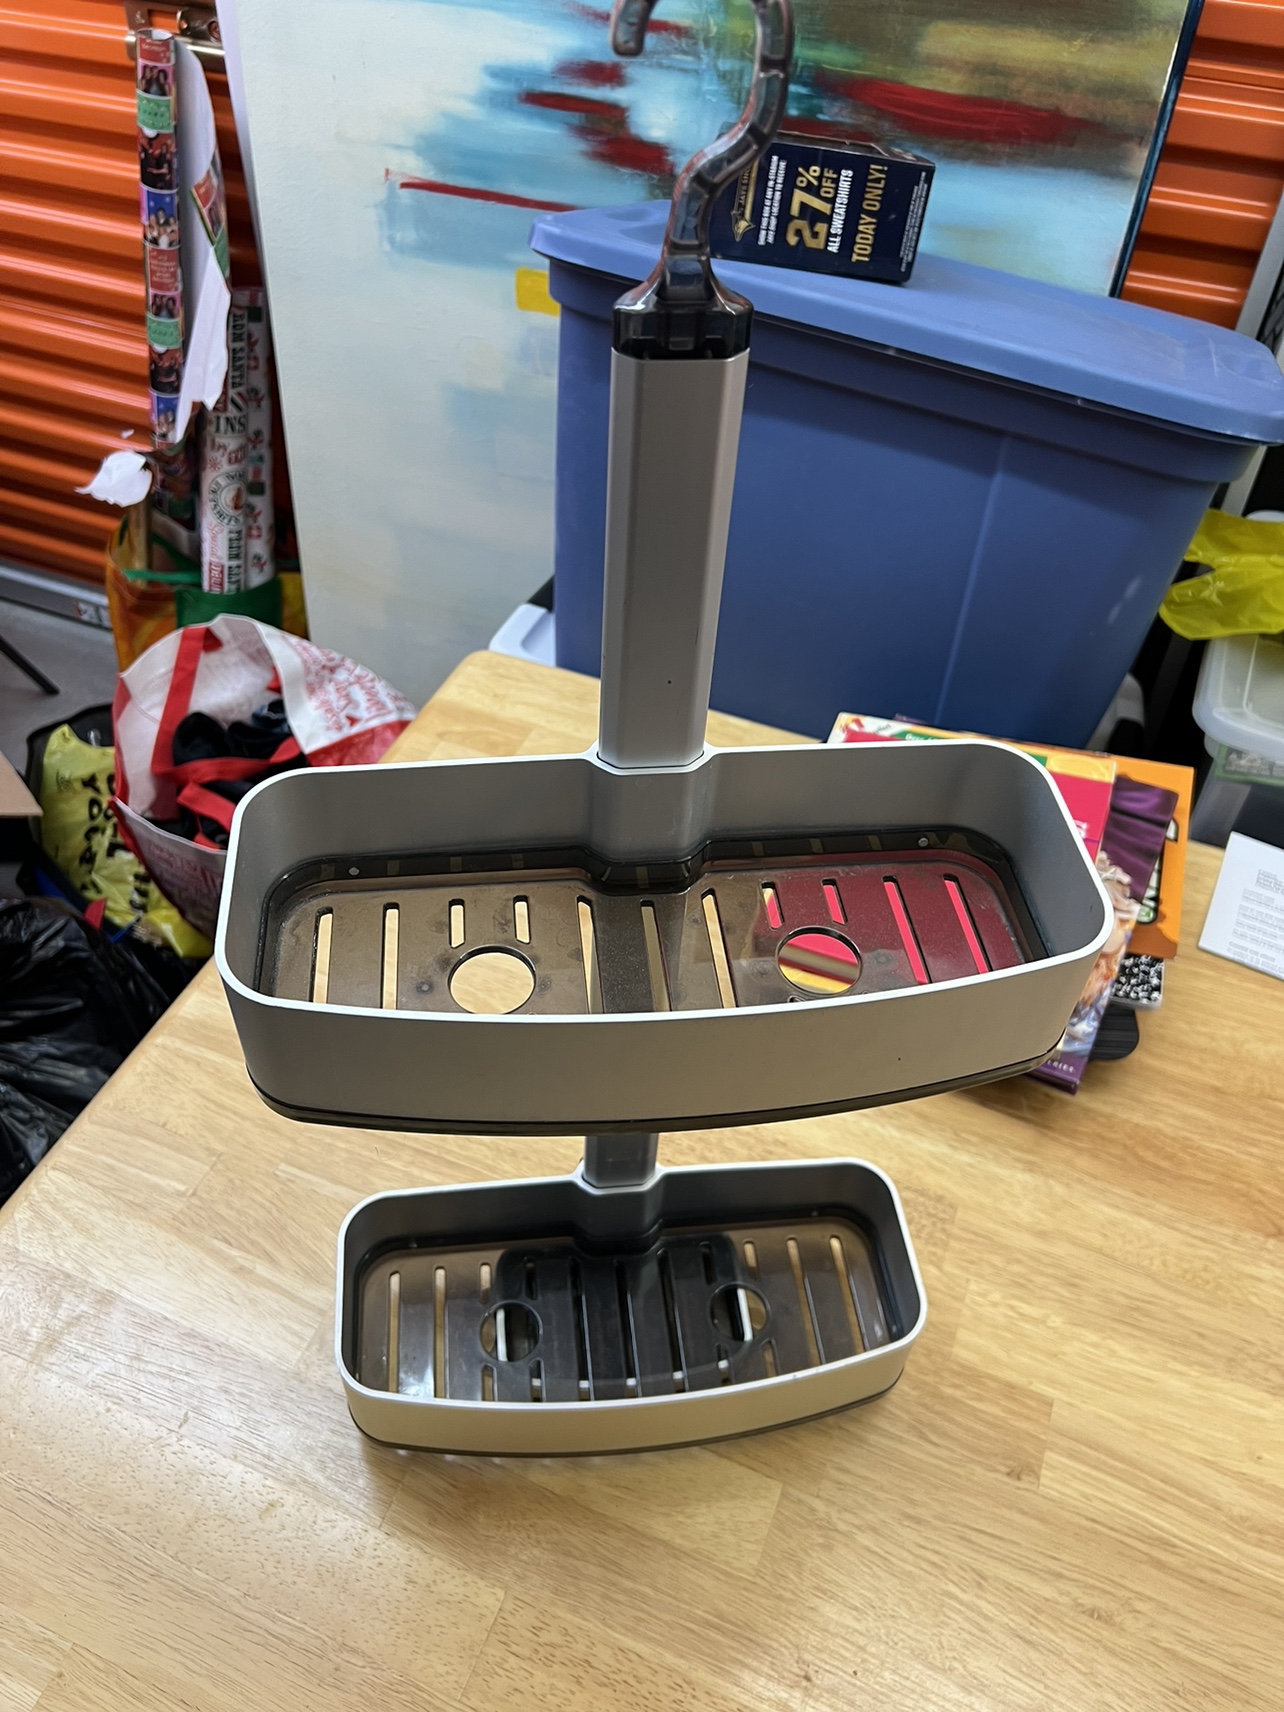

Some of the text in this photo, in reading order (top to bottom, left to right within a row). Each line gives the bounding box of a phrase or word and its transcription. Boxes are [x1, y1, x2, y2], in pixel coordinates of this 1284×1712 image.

[767, 155, 779, 187] IN-STADIUM
[765, 187, 774, 199] ANY
[775, 183, 784, 191] TO
[762, 206, 771, 217] BOX
[771, 191, 782, 216] LOCATION
[786, 166, 838, 249] 27% OFF
[827, 169, 854, 254] ALL SWEATSHIRTS
[851, 164, 889, 262] TODAY ONLY!
[760, 217, 769, 229] THIS
[757, 229, 768, 245] SHOW
[231, 347, 246, 389] SANTA
